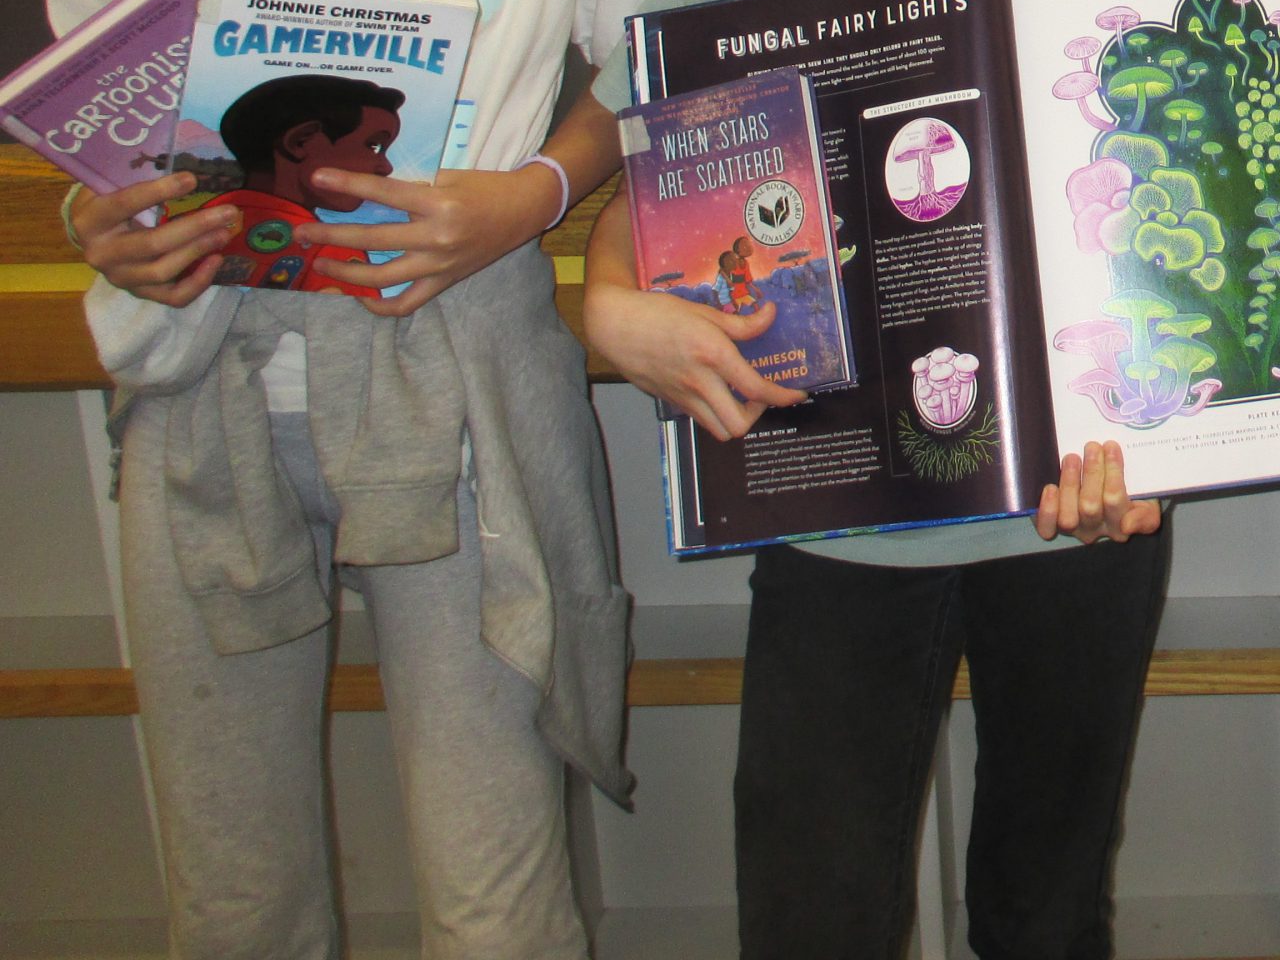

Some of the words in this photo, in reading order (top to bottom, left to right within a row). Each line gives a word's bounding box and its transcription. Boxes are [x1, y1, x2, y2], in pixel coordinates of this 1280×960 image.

[255, 13, 314, 25] AWARD-WINNING
[315, 18, 342, 27] AUTHOR
[355, 21, 387, 31] SWIM
[390, 24, 420, 33] TEAM
[330, 6, 432, 25] CHRISTMAS
[717, 25, 809, 60] FUNGAL
[817, 10, 876, 40] FAIRY
[213, 19, 452, 75] GAMERVILLE
[808, 59, 820, 68] SEEM
[823, 56, 834, 64] LIKE
[836, 53, 848, 62] THEY
[850, 49, 868, 59] SHOULD
[870, 46, 881, 55] ONLY
[882, 42, 900, 52] BELONG
[909, 38, 922, 46] FAIRY
[925, 34, 942, 43] TALES.
[264, 59, 293, 68] GAME
[336, 64, 364, 72] GAME
[826, 65, 841, 75] around
[842, 63, 850, 71] the
[904, 50, 916, 58] about
[917, 47, 926, 55] 100
[928, 44, 944, 54] species
[864, 69, 879, 79] species
[896, 62, 908, 72] being
[96, 64, 128, 86] the
[883, 102, 914, 113] STRUCTURE
[935, 91, 971, 103] MUSHROOM
[661, 126, 709, 162] WHEN
[719, 112, 769, 149] STARS
[659, 169, 687, 201] ARE
[696, 146, 784, 192] SCATTERED
[747, 188, 765, 230] NATIONAL
[766, 183, 787, 193] BOOK
[787, 190, 802, 220] AWARD
[761, 227, 794, 243] FINALIST
[750, 348, 806, 369] AMIESON
[765, 366, 808, 382] HAMED
[1248, 412, 1267, 420] PLATE
